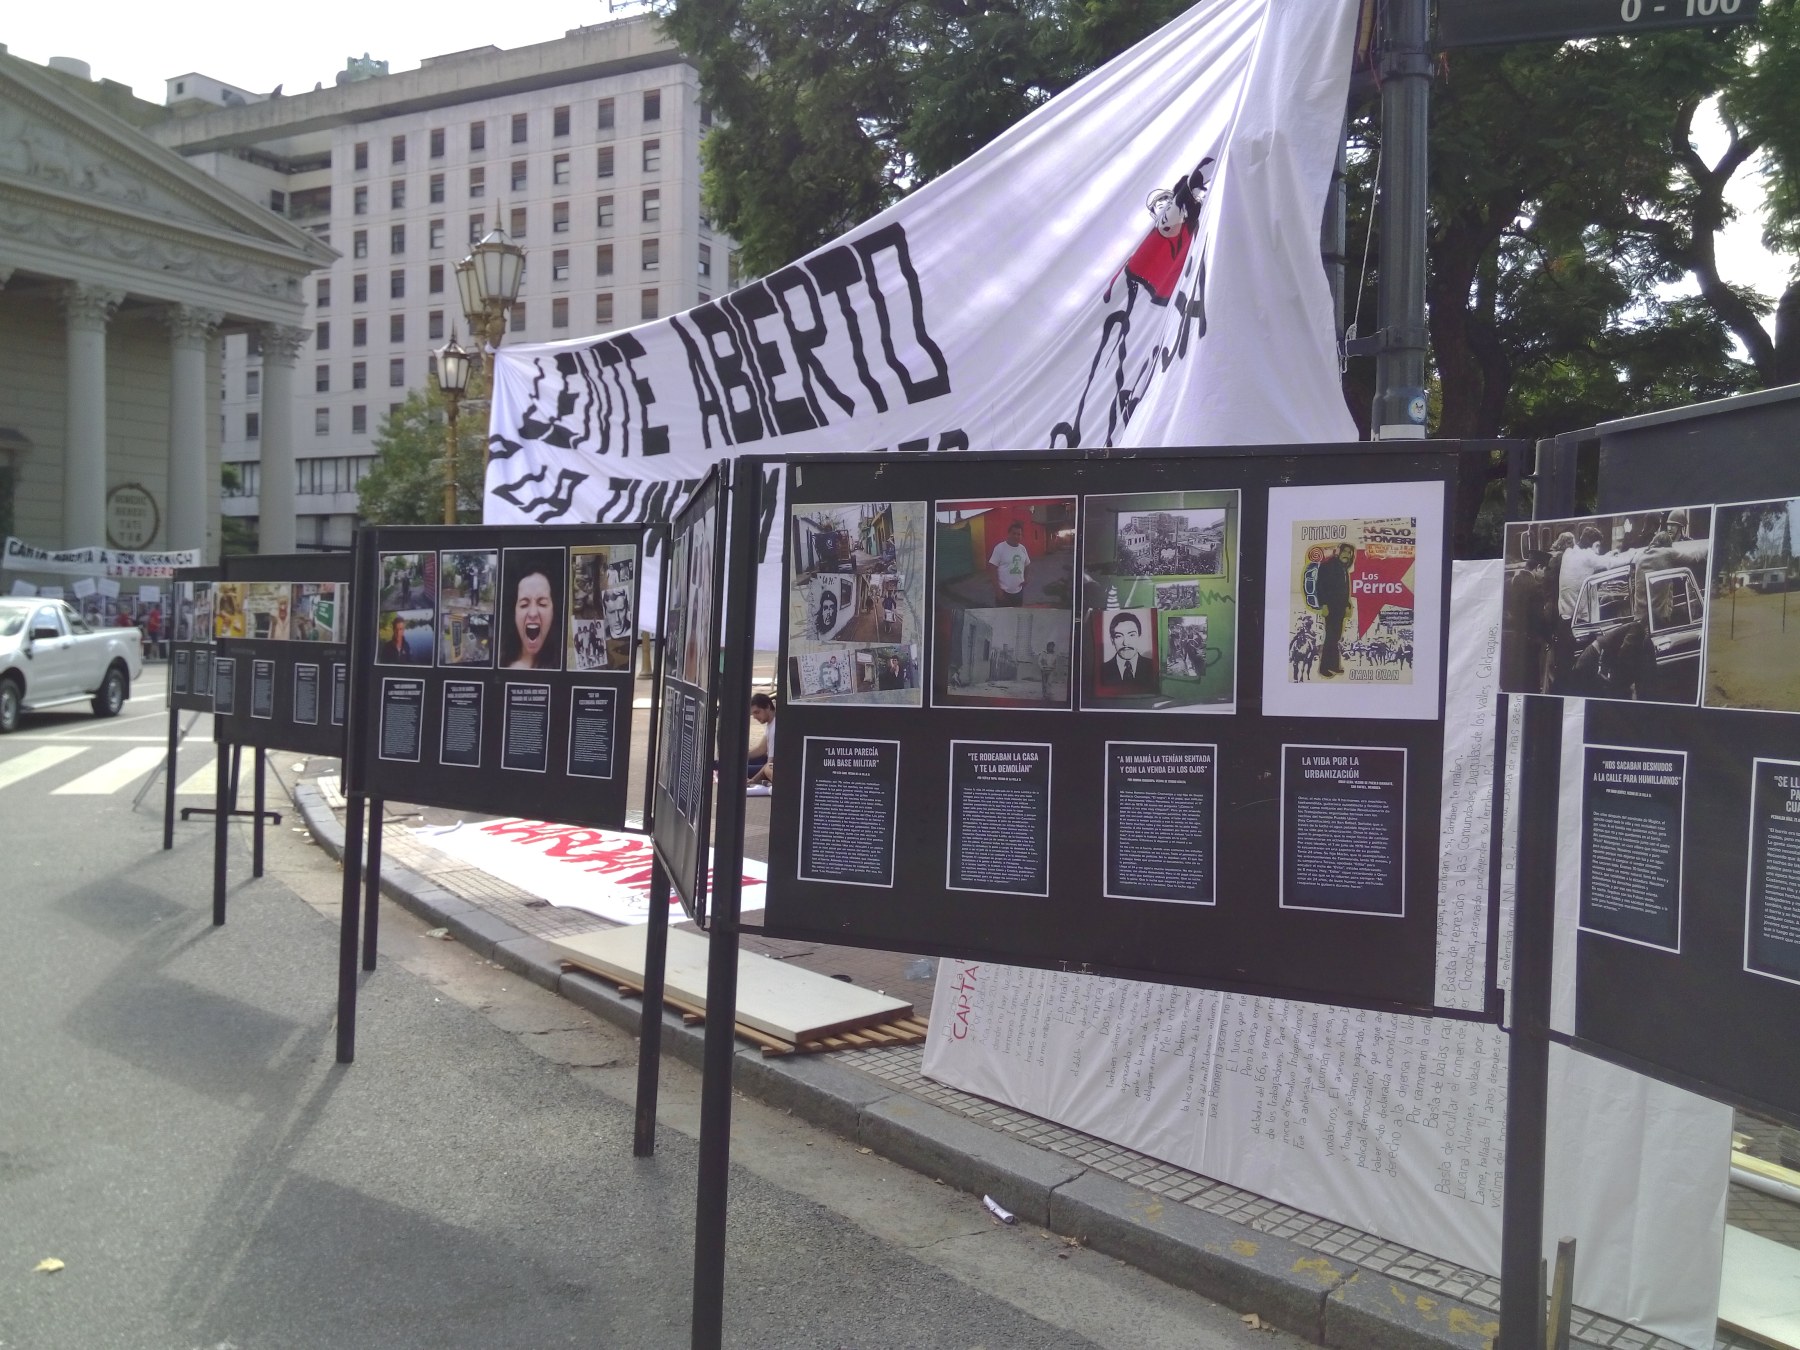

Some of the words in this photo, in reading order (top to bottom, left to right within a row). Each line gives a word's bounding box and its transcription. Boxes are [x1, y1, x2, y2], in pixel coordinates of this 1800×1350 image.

[669, 221, 951, 448] ABIERTO
[1301, 525, 1346, 540] PITINGO
[1362, 571, 1378, 581] Los
[1352, 579, 1403, 594] Perros
[1349, 669, 1374, 680] OMAR
[837, 748, 852, 756] VILLA
[854, 746, 878, 756] PARECÍA
[980, 753, 1011, 761] RODEABAN
[1013, 753, 1021, 761] LA
[1022, 753, 1038, 761] CASA
[1184, 755, 1210, 763] SENTADA
[1302, 757, 1311, 765] LA
[1313, 757, 1331, 765] VIDA
[1333, 757, 1347, 765] POR
[1350, 757, 1359, 765] LA
[824, 759, 835, 767] UNA
[837, 759, 852, 767] BASE
[1617, 761, 1641, 770] SACABAN
[1643, 762, 1672, 772] DESNUDOS
[1120, 766, 1124, 774] Y
[1304, 768, 1360, 778] URBANIZACIÓN
[1593, 773, 1597, 781] A
[1599, 773, 1605, 781] LA
[1606, 773, 1622, 782] CALLE
[1623, 774, 1637, 783] PARA
[1430, 1045, 1449, 1077] balas
[1423, 1097, 1440, 1129] Basta
[1434, 1162, 1451, 1195] Basta
